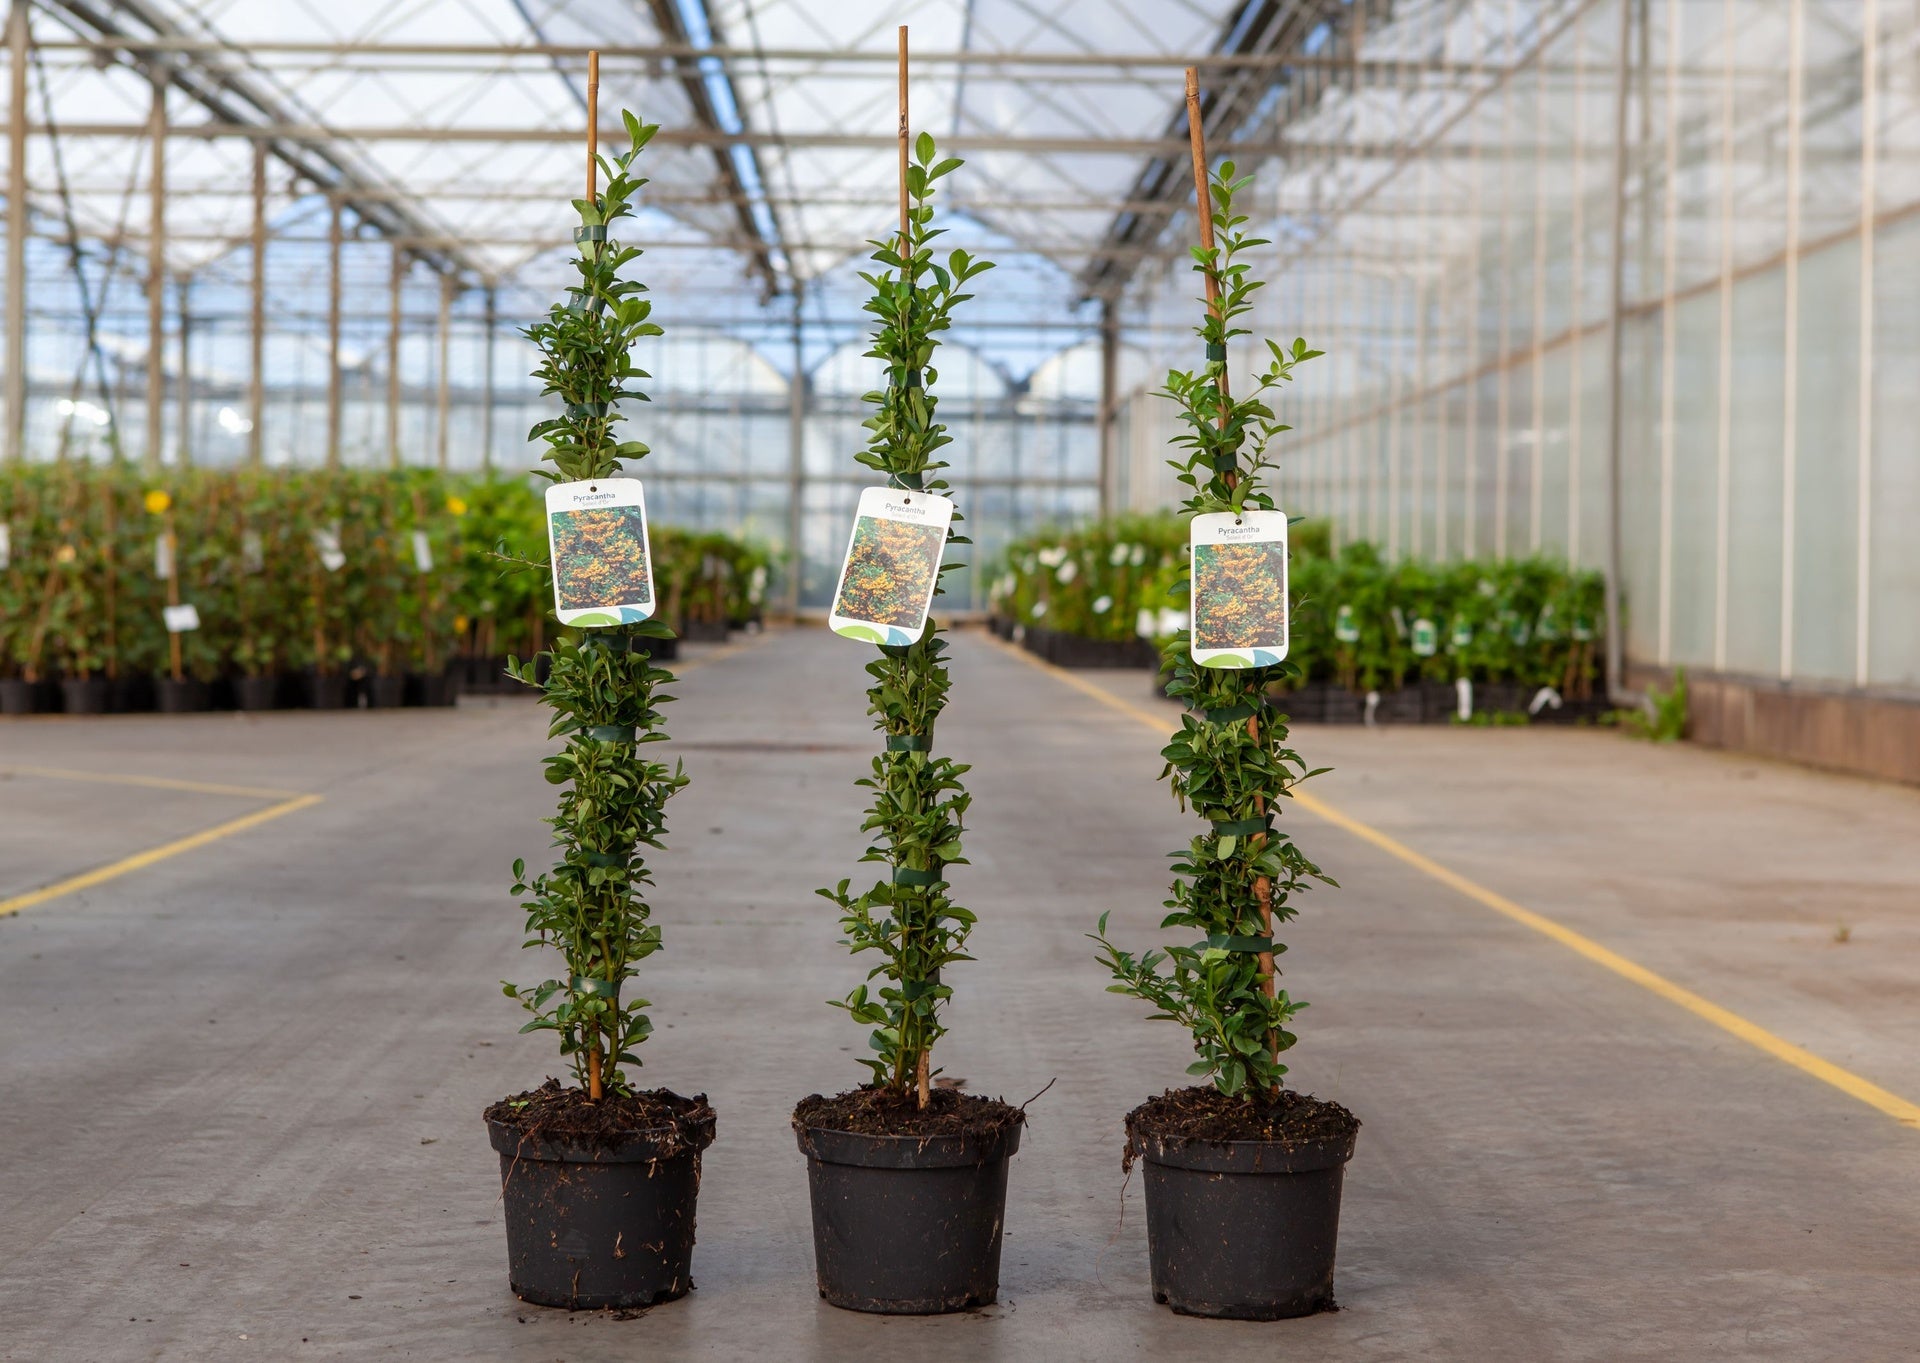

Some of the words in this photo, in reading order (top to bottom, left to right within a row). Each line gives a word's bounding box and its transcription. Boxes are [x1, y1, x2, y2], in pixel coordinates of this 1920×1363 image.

[573, 492, 616, 503] Pyracantha
[885, 502, 926, 515] Pyracantha
[1218, 526, 1260, 536] Pyracantha
